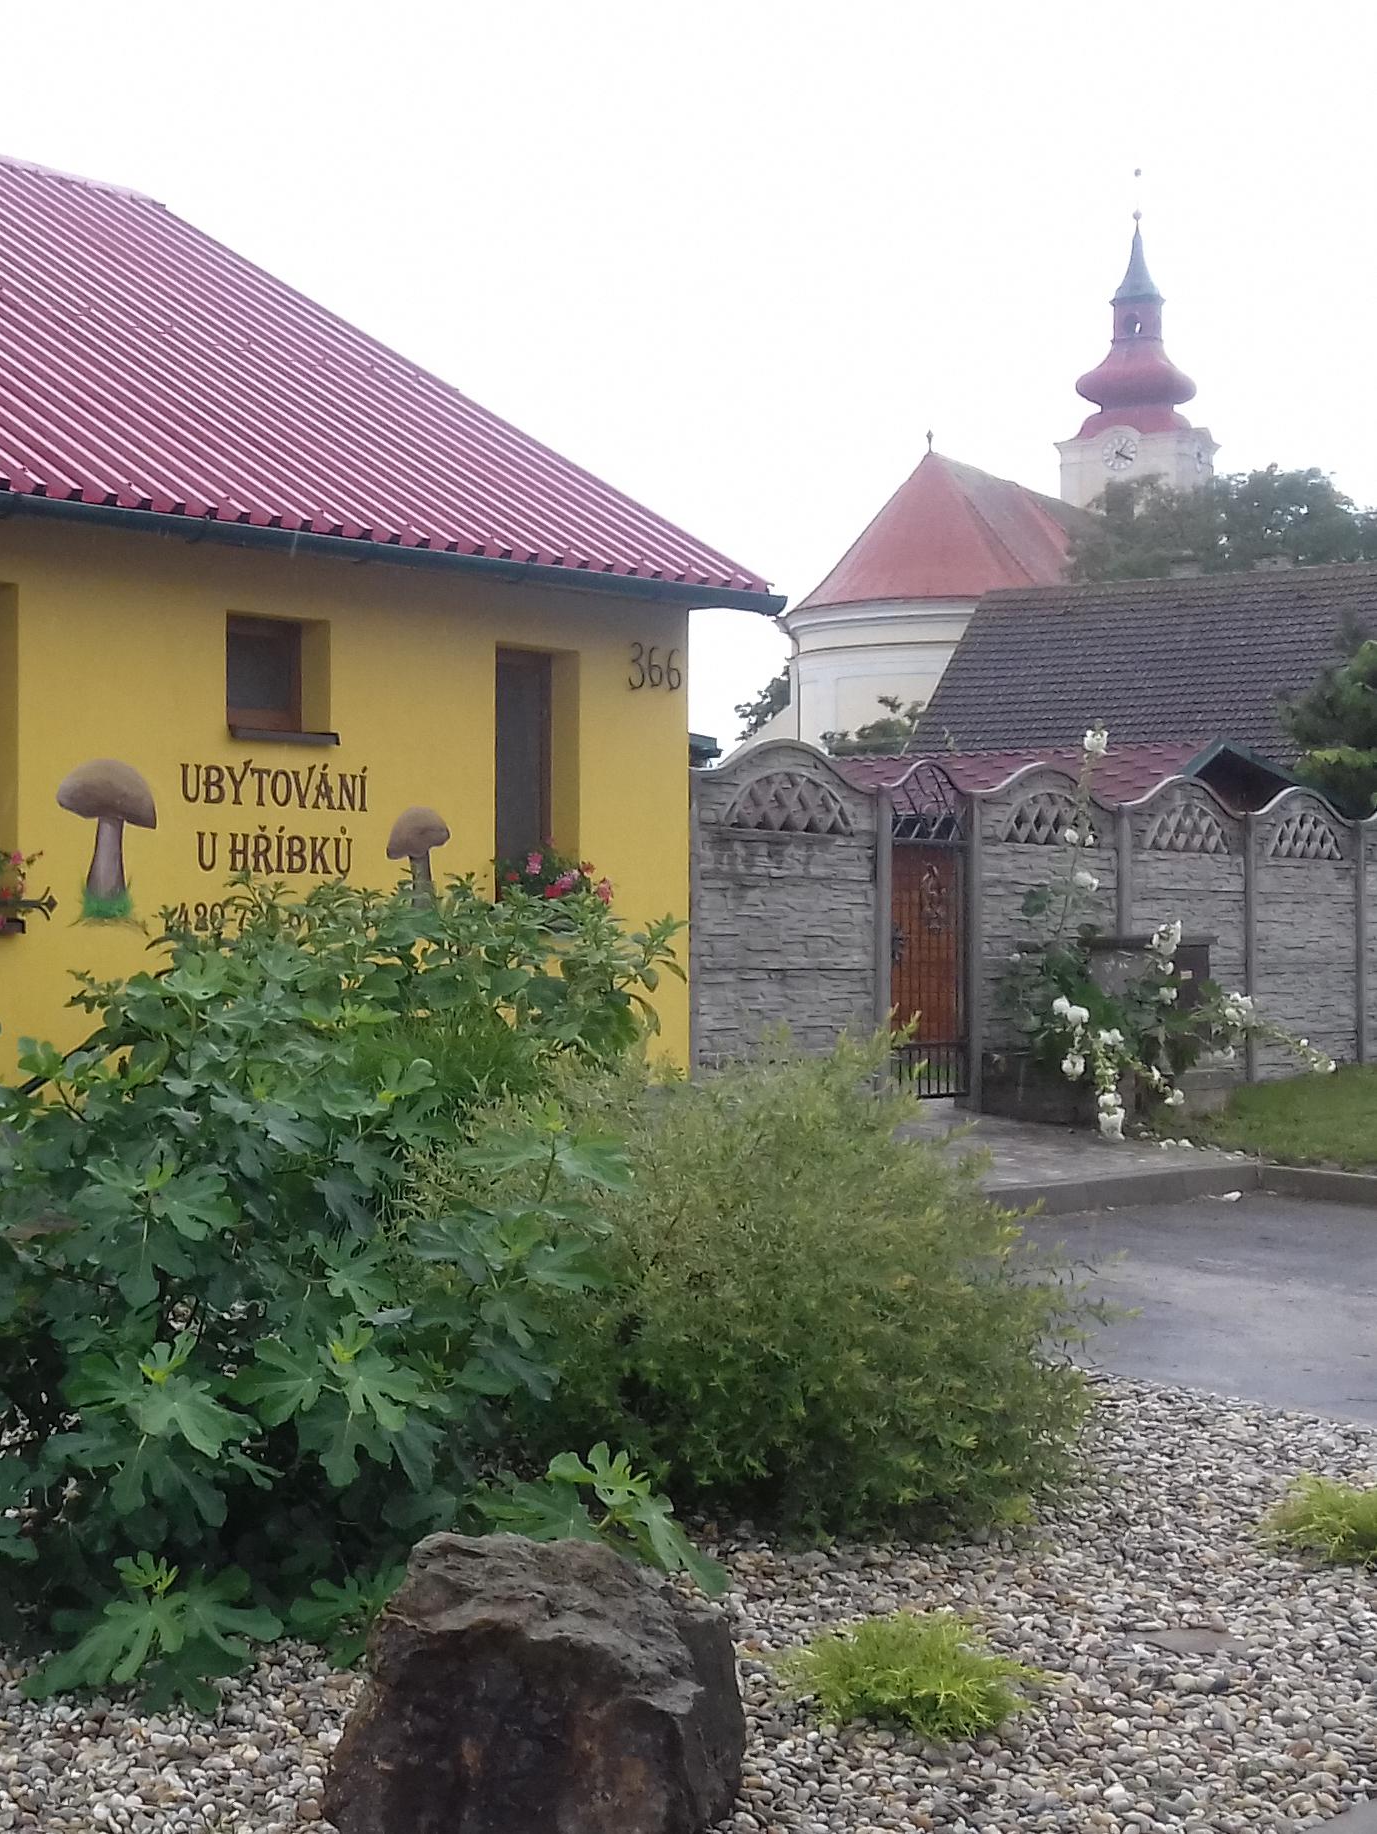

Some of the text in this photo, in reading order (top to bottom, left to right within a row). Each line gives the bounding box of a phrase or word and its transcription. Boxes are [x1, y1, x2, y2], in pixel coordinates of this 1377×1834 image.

[628, 641, 681, 691] 366
[196, 824, 353, 876] U HŘÍBKŮ
